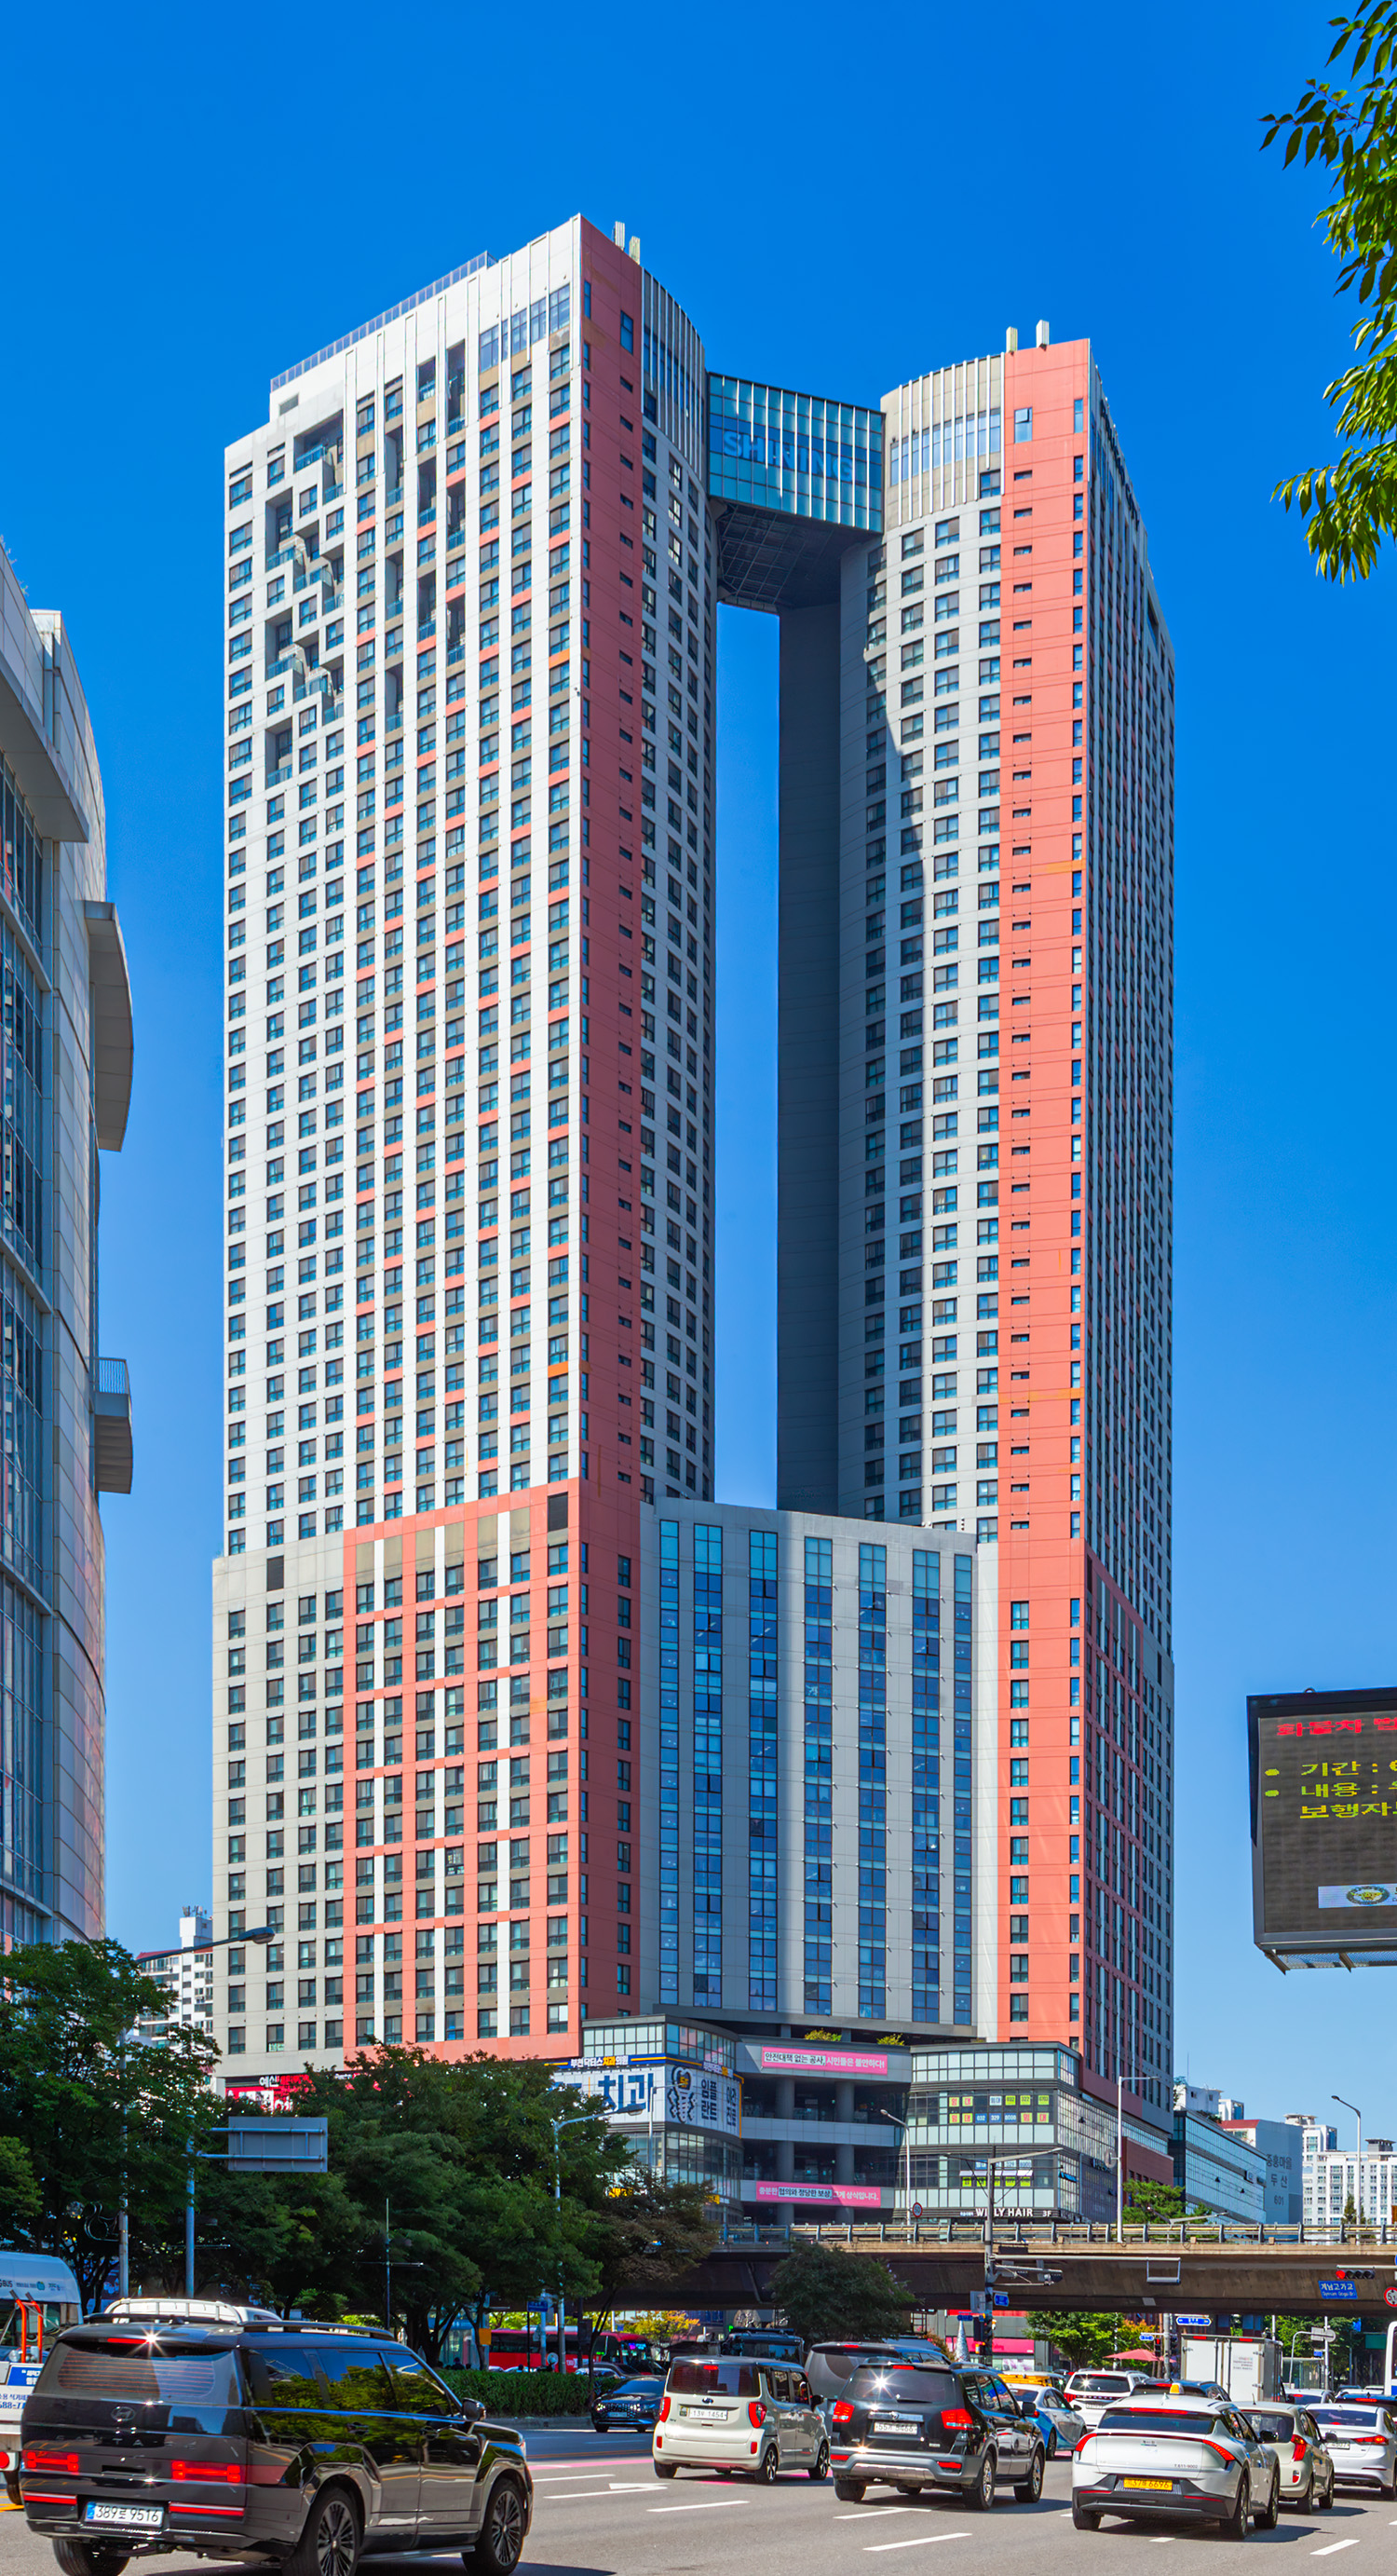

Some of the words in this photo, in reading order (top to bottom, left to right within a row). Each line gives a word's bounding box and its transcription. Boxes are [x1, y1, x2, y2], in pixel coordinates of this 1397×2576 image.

[723, 430, 853, 482] SHINING
[1301, 1761, 1361, 1777] 기간
[1301, 1782, 1361, 1798] 내용
[765, 2051, 793, 2063] 안전대책
[793, 2054, 808, 2064] 없는
[809, 2055, 826, 2066] 공사,
[827, 2056, 854, 2067] 시민들은
[855, 2058, 885, 2069] 불안하다!
[598, 2073, 654, 2112] 치과
[1267, 2153, 1293, 2170] 중흥마을
[798, 2188, 817, 2198] 정당한
[1273, 2195, 1284, 2206] 601
[975, 2208, 1005, 2217] WILY
[1009, 2208, 1034, 2217] HAIR
[1321, 2283, 1354, 2291] 계남고가교
[129, 2507, 159, 2522] 9516
